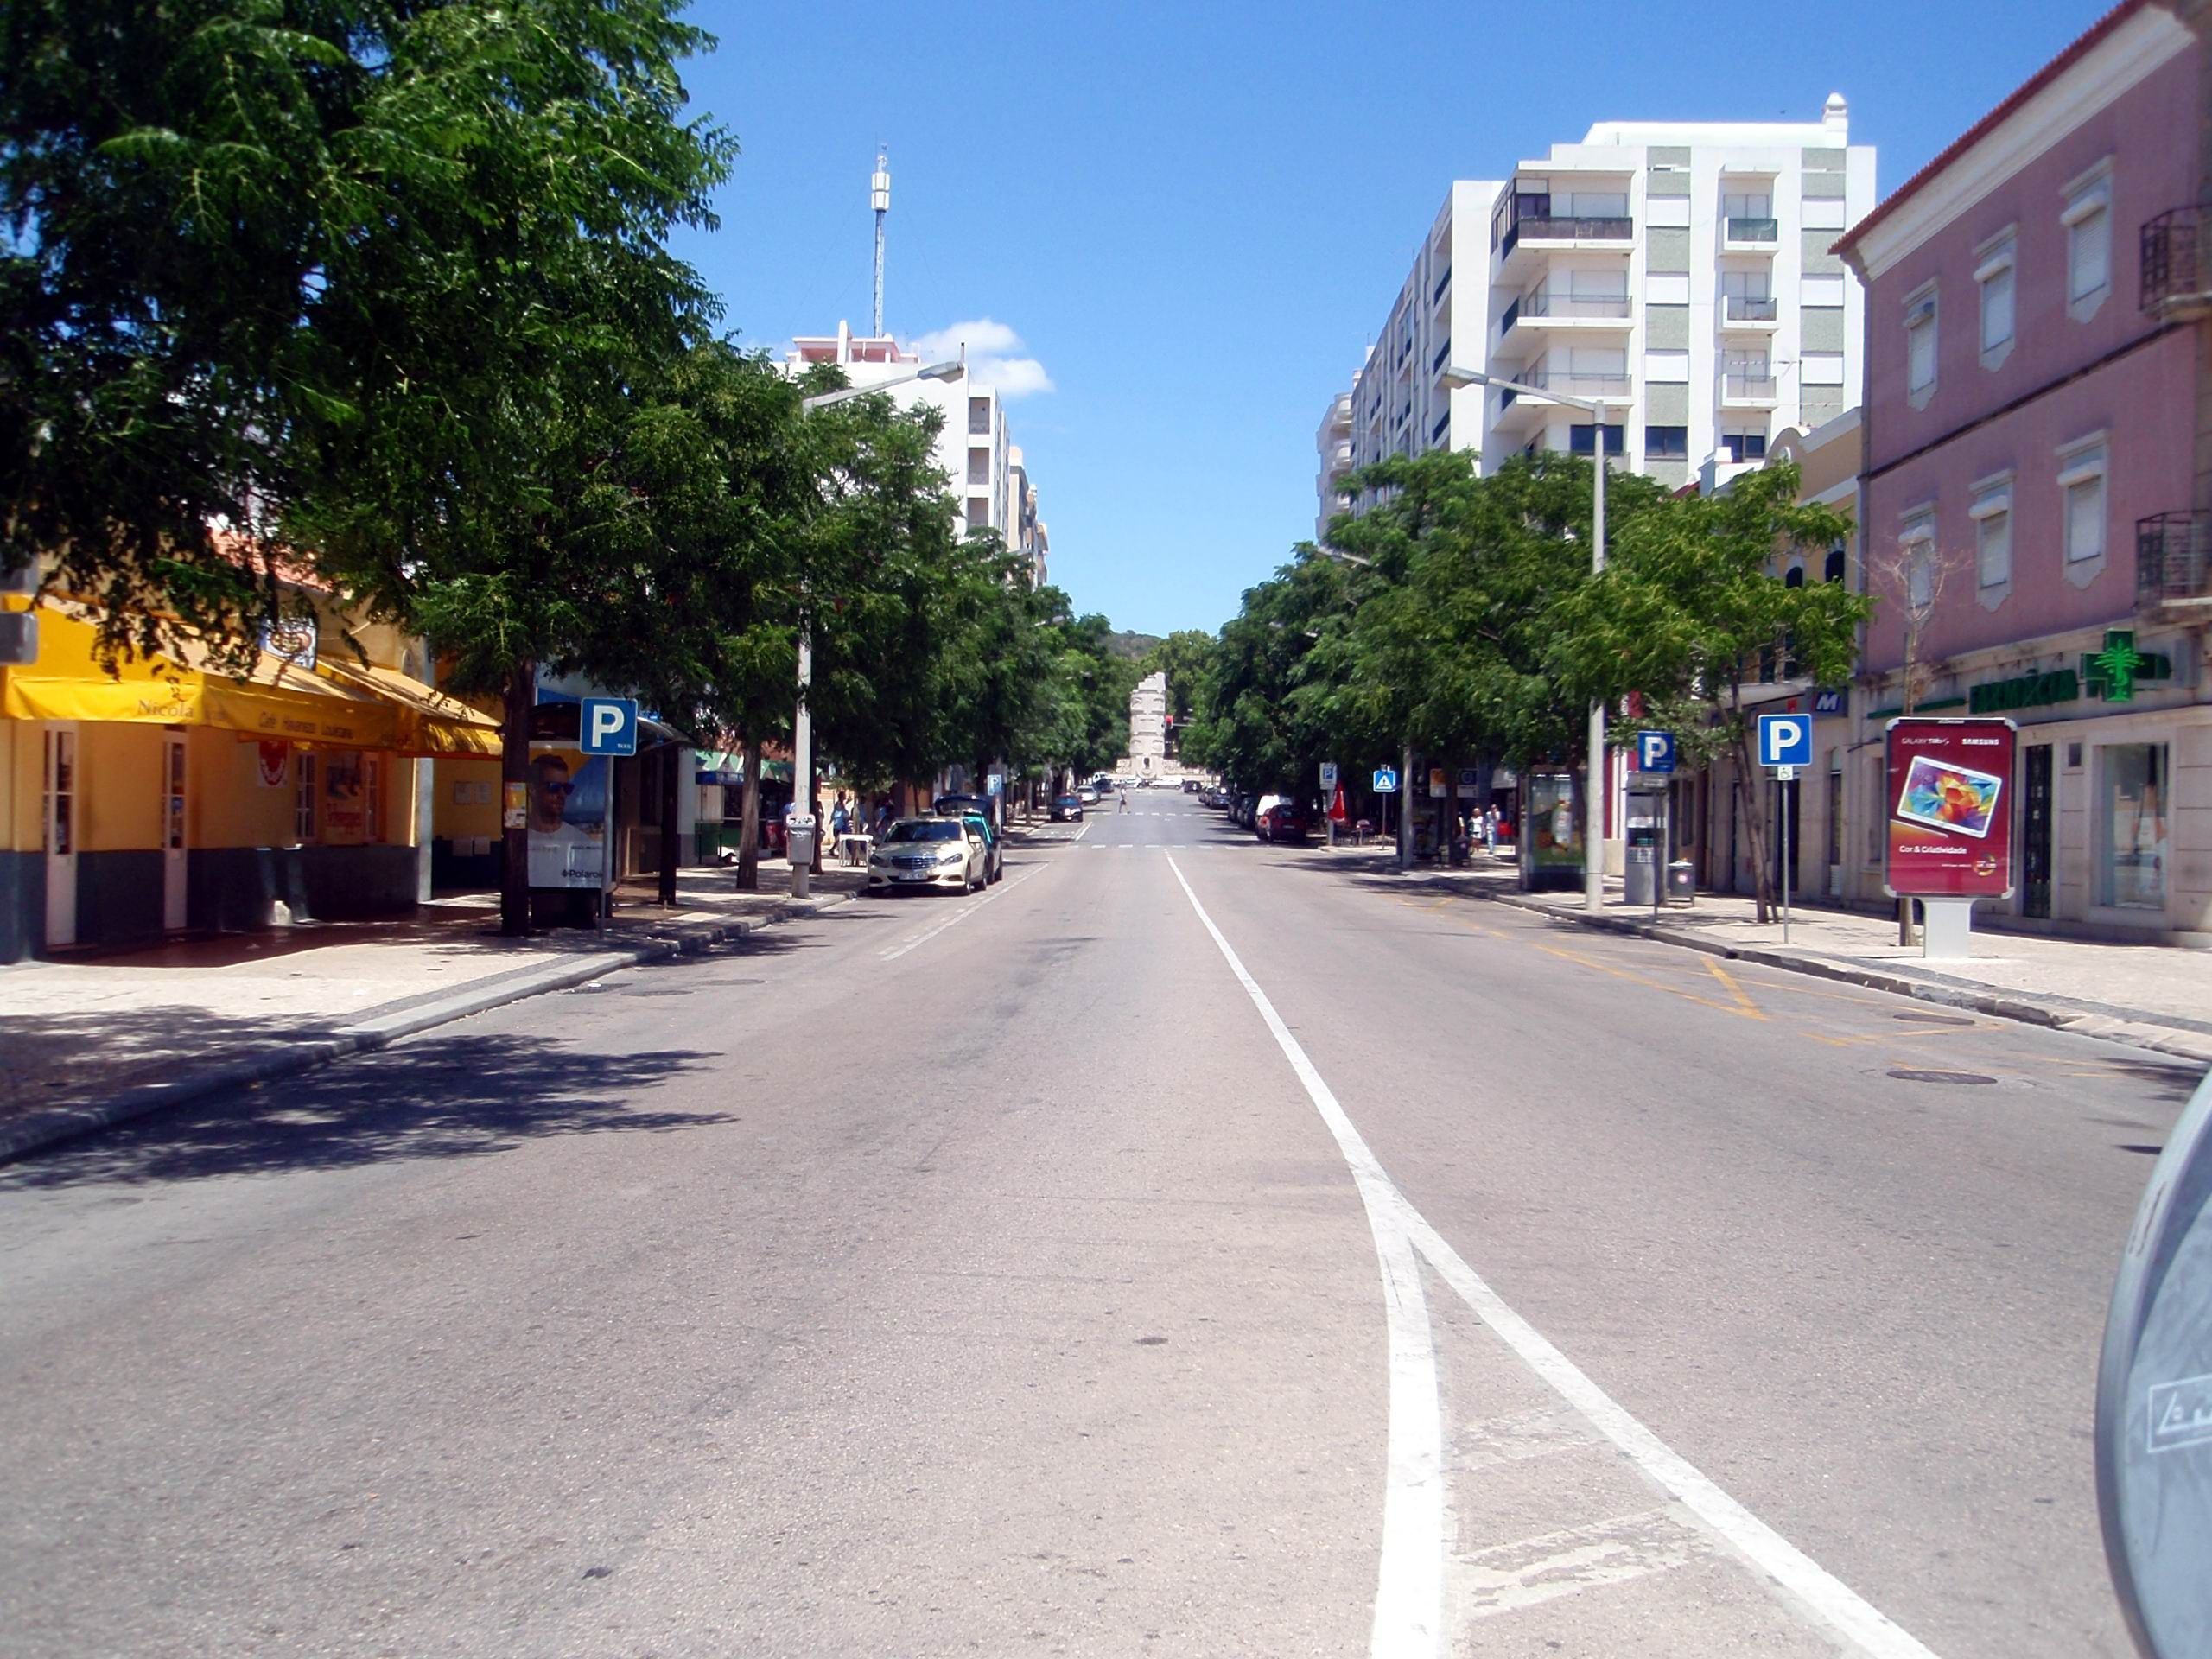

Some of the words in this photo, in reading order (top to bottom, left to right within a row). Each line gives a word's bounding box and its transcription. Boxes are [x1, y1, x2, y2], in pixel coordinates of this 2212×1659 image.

[138, 699, 194, 718] Nicola
[592, 705, 624, 747] P
[1644, 737, 1668, 768] P
[1770, 721, 1802, 760] P
[1899, 845, 1913, 854] Cor
[1921, 846, 1967, 855] Criatividade
[569, 869, 602, 878] Polaroi
